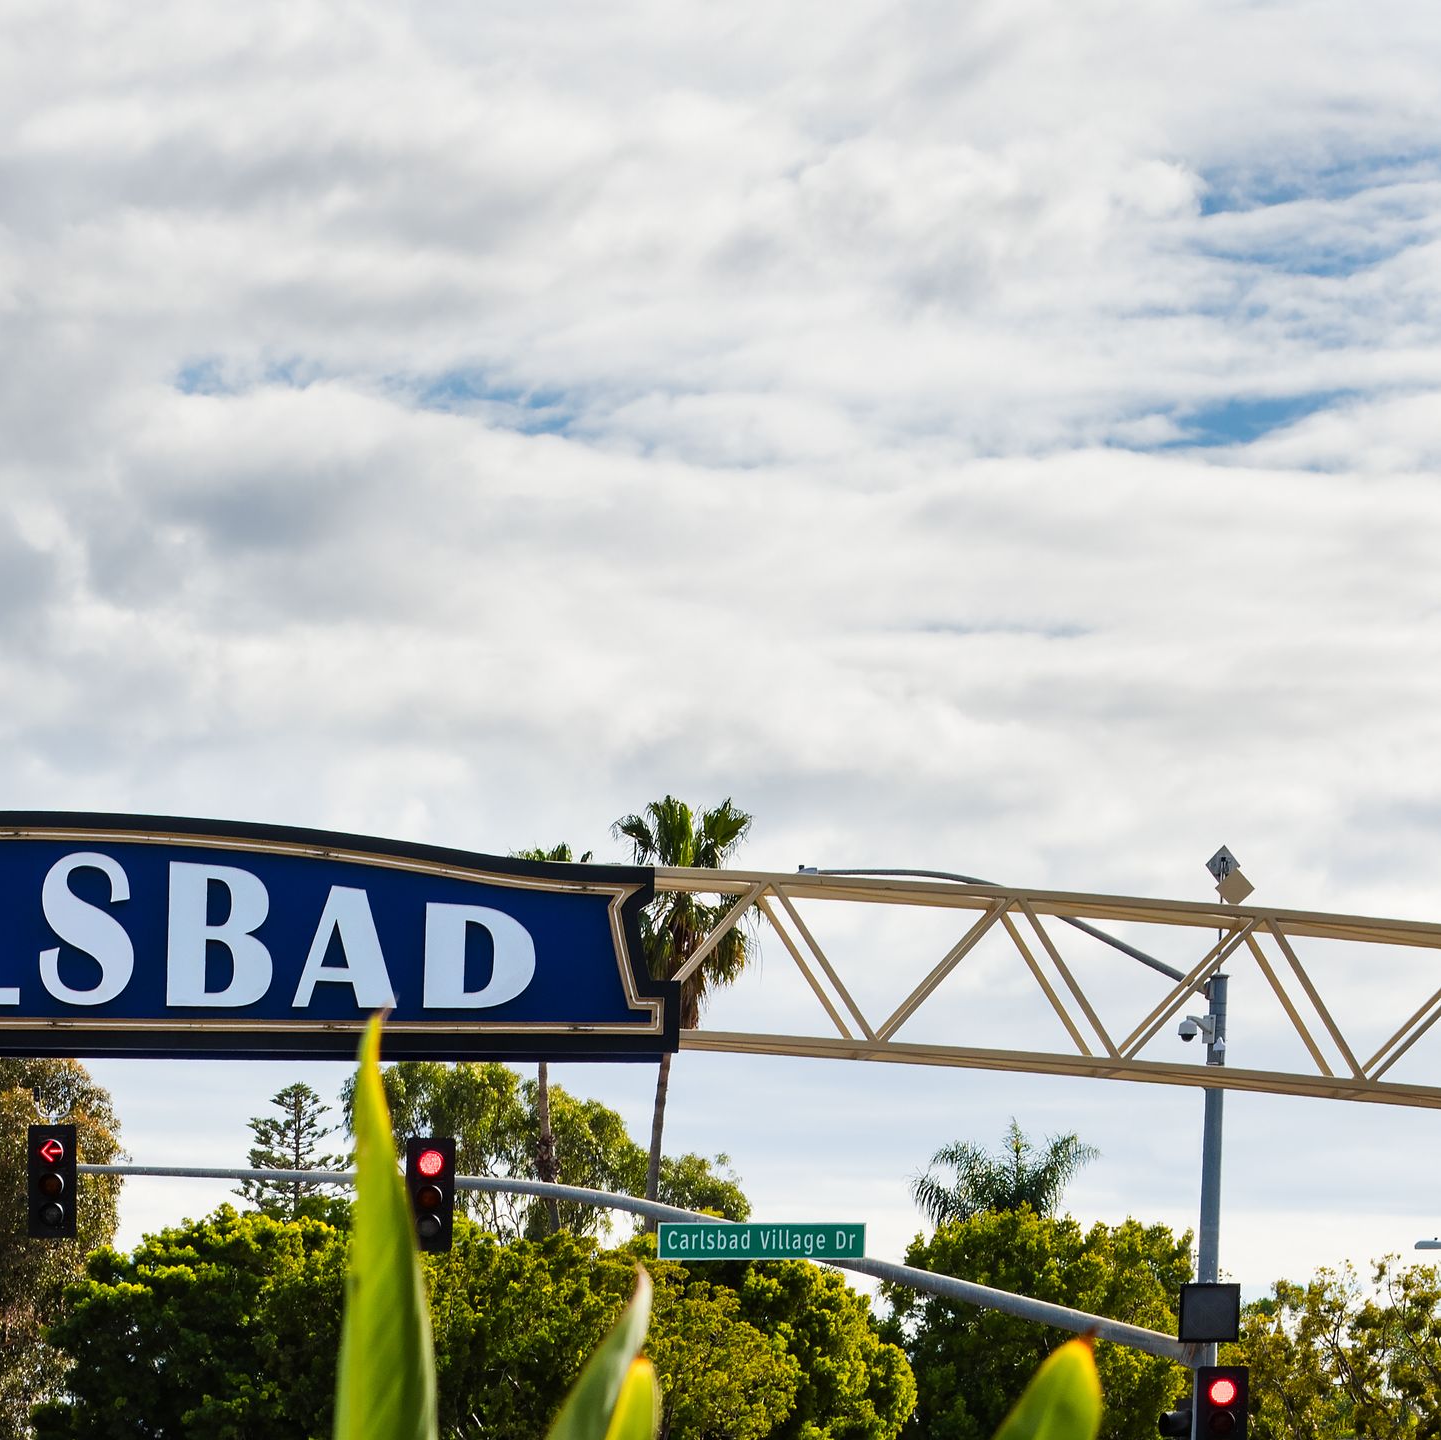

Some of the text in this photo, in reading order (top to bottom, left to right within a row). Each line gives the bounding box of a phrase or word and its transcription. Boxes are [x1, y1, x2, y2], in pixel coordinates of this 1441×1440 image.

[667, 1229, 856, 1255] Carlsbad Village Dr
